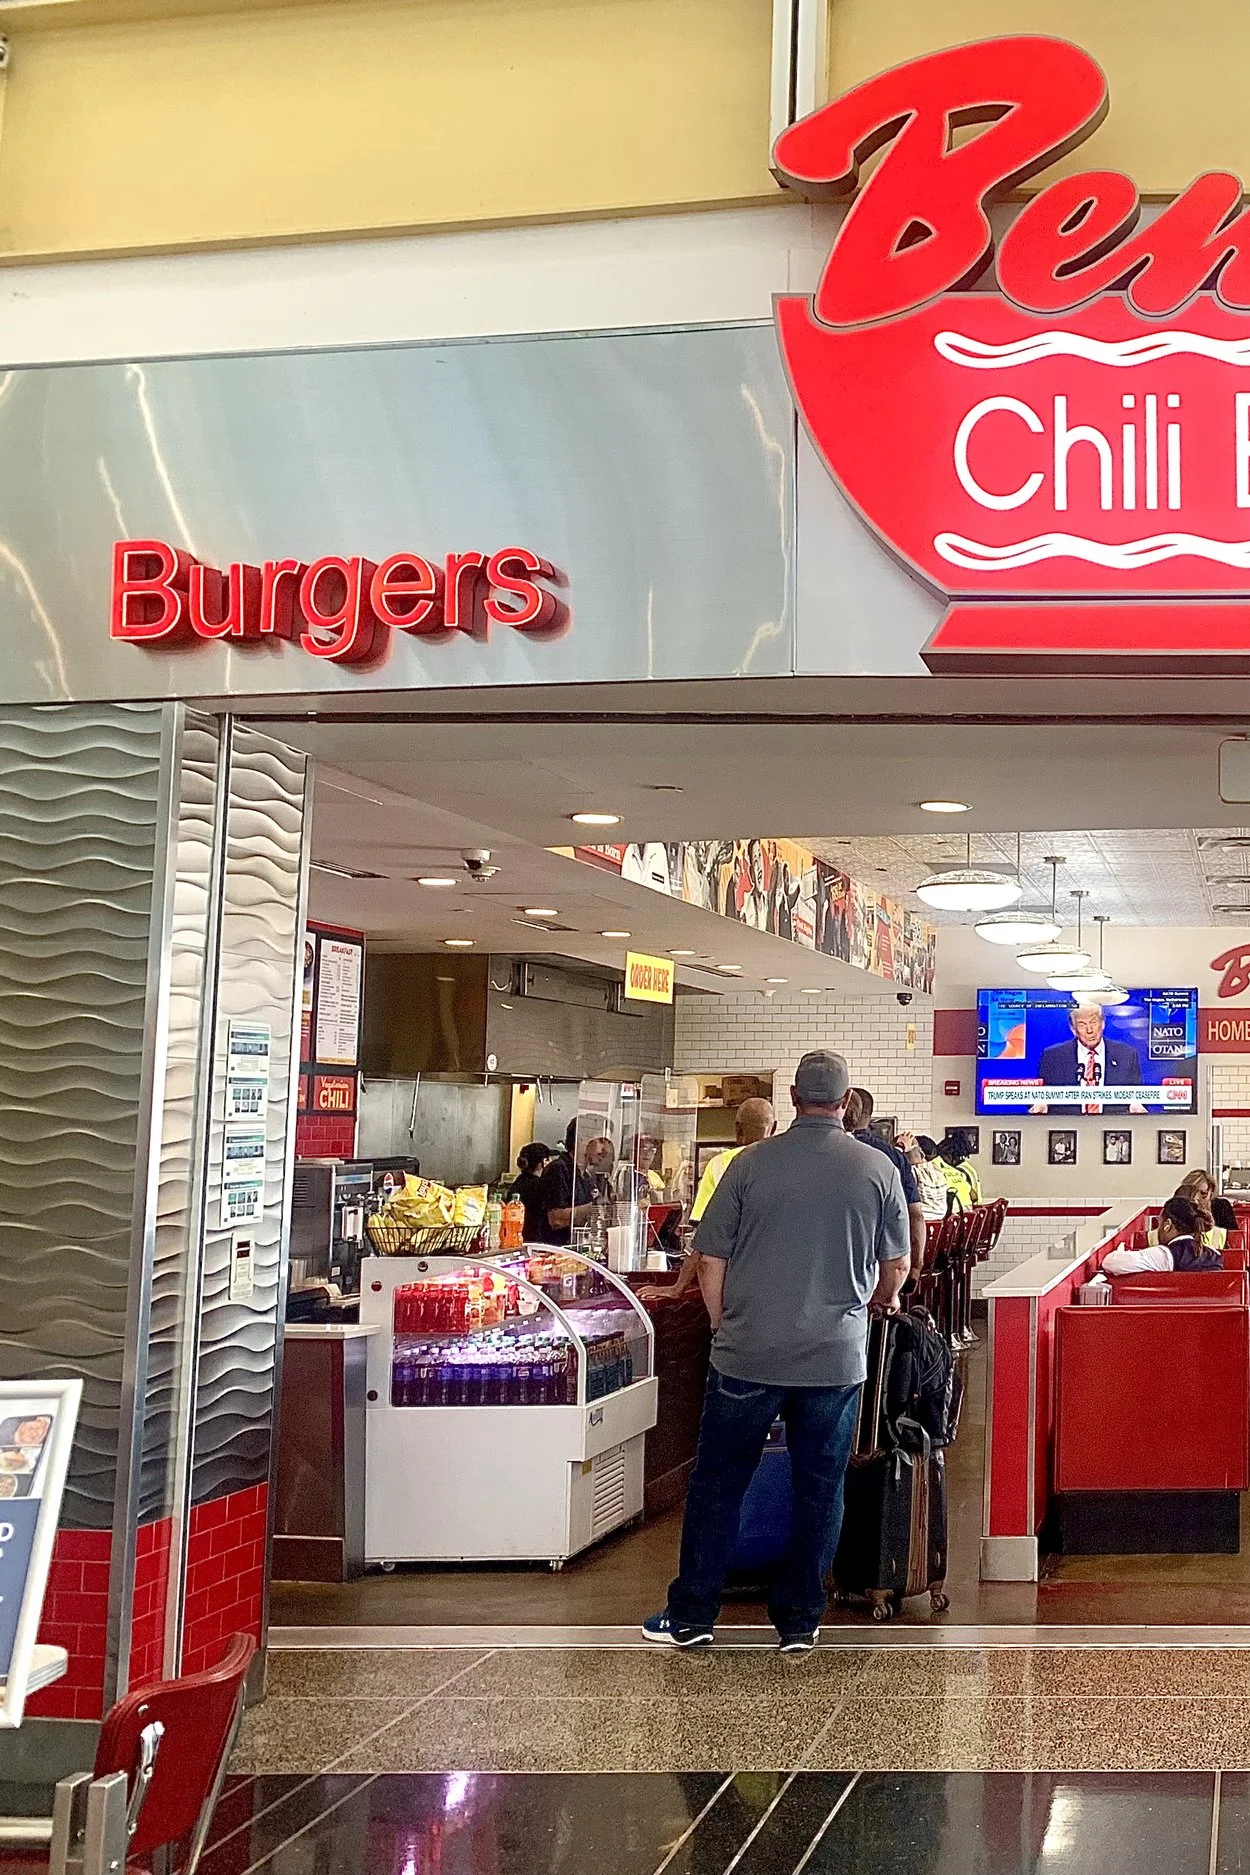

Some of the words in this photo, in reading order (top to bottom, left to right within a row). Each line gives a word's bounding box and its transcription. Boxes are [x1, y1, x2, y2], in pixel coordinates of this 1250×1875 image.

[952, 393, 1183, 512] Chili
[109, 537, 558, 662] Burgers
[630, 962, 652, 990] ORDER
[652, 967, 669, 993] HERE
[1153, 1027, 1184, 1037] NATO
[1152, 1044, 1184, 1054] OTAN
[319, 1089, 349, 1109] CHILI
[988, 1091, 1004, 1100] TRUMP
[1005, 1091, 1024, 1100] SPEAKS
[1024, 1091, 1031, 1100] AT
[1031, 1091, 1045, 1100] NATO
[1045, 1091, 1064, 1100] SUMMIT
[1064, 1091, 1080, 1100] AFTER
[1080, 1091, 1092, 1100] IRAN
[1113, 1091, 1134, 1100] MIDEAST
[1135, 1091, 1161, 1100] CEASEFIRE
[1166, 1090, 1188, 1100] CNN
